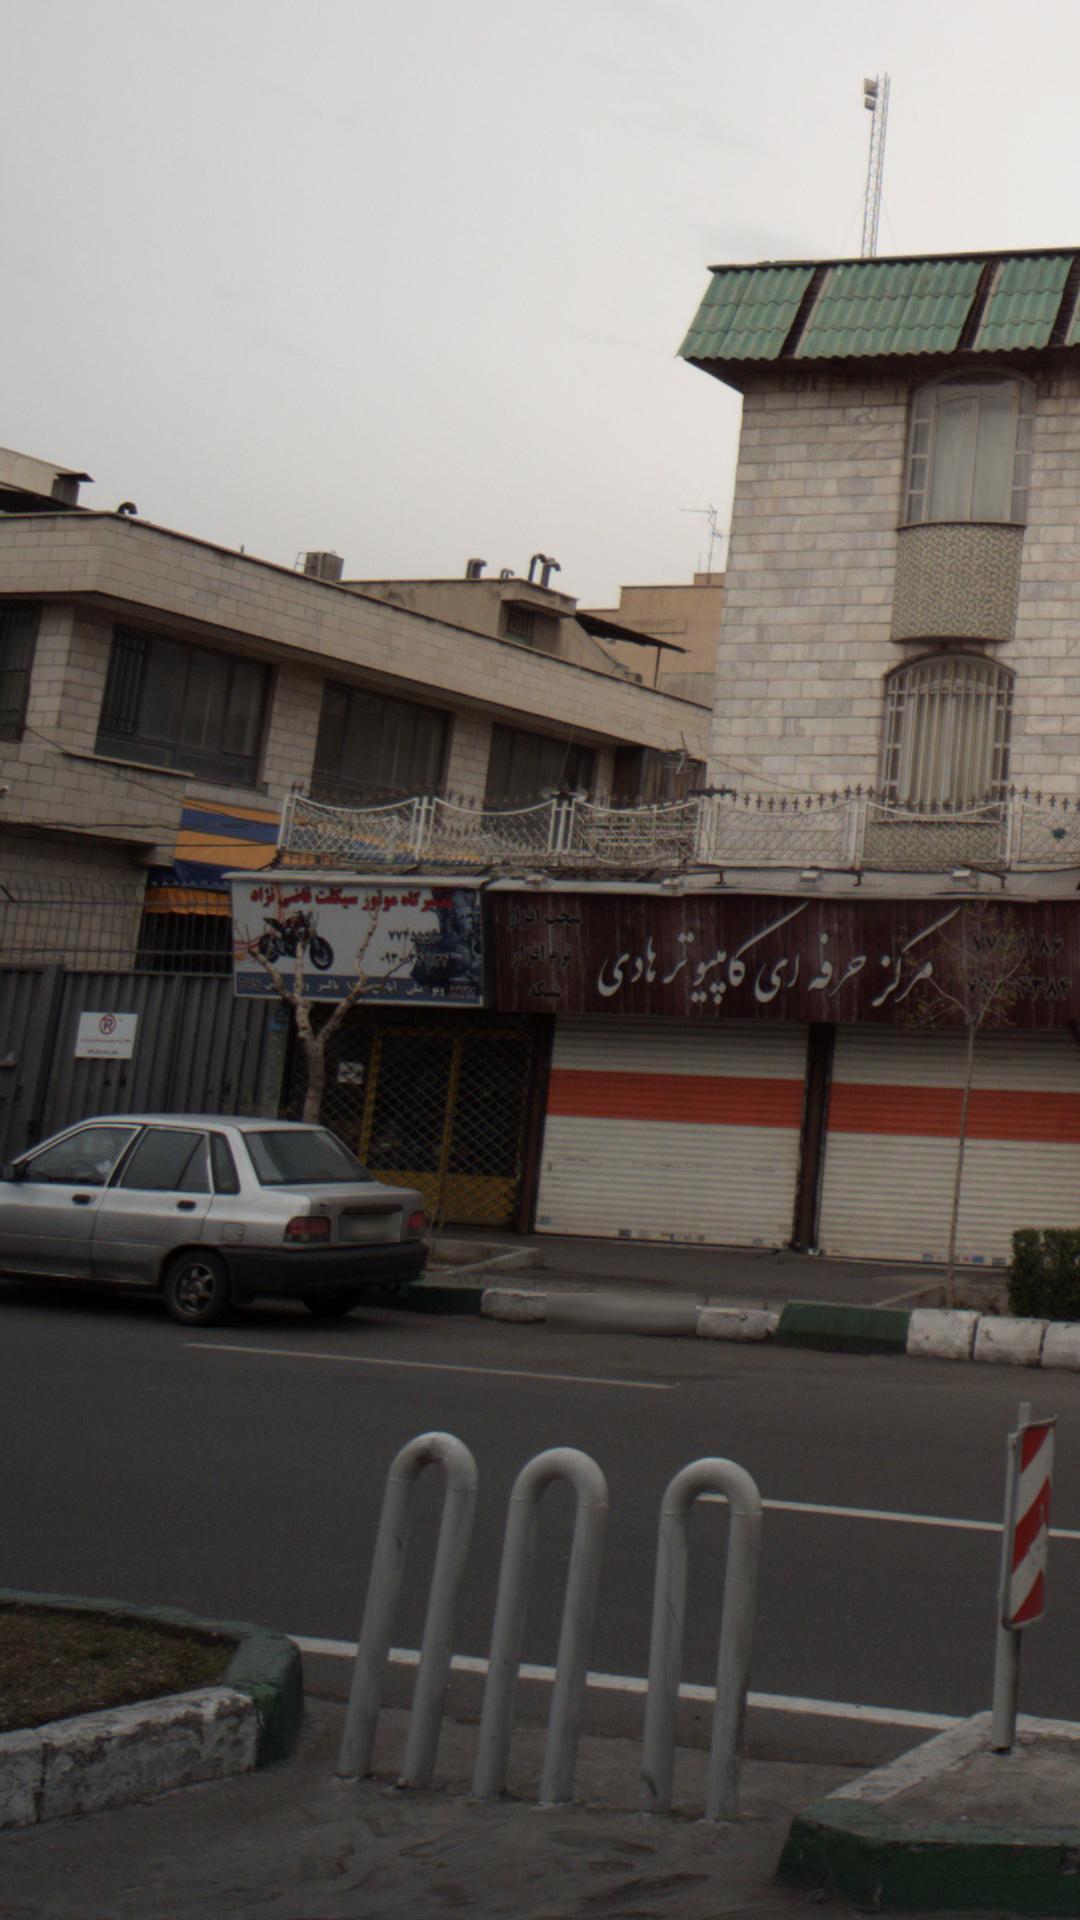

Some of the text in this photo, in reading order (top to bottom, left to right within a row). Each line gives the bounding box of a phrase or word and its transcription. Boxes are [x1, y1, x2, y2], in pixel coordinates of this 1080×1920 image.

[597, 901, 961, 1007] مرکز حرفه ای کامپیوتر هادی
